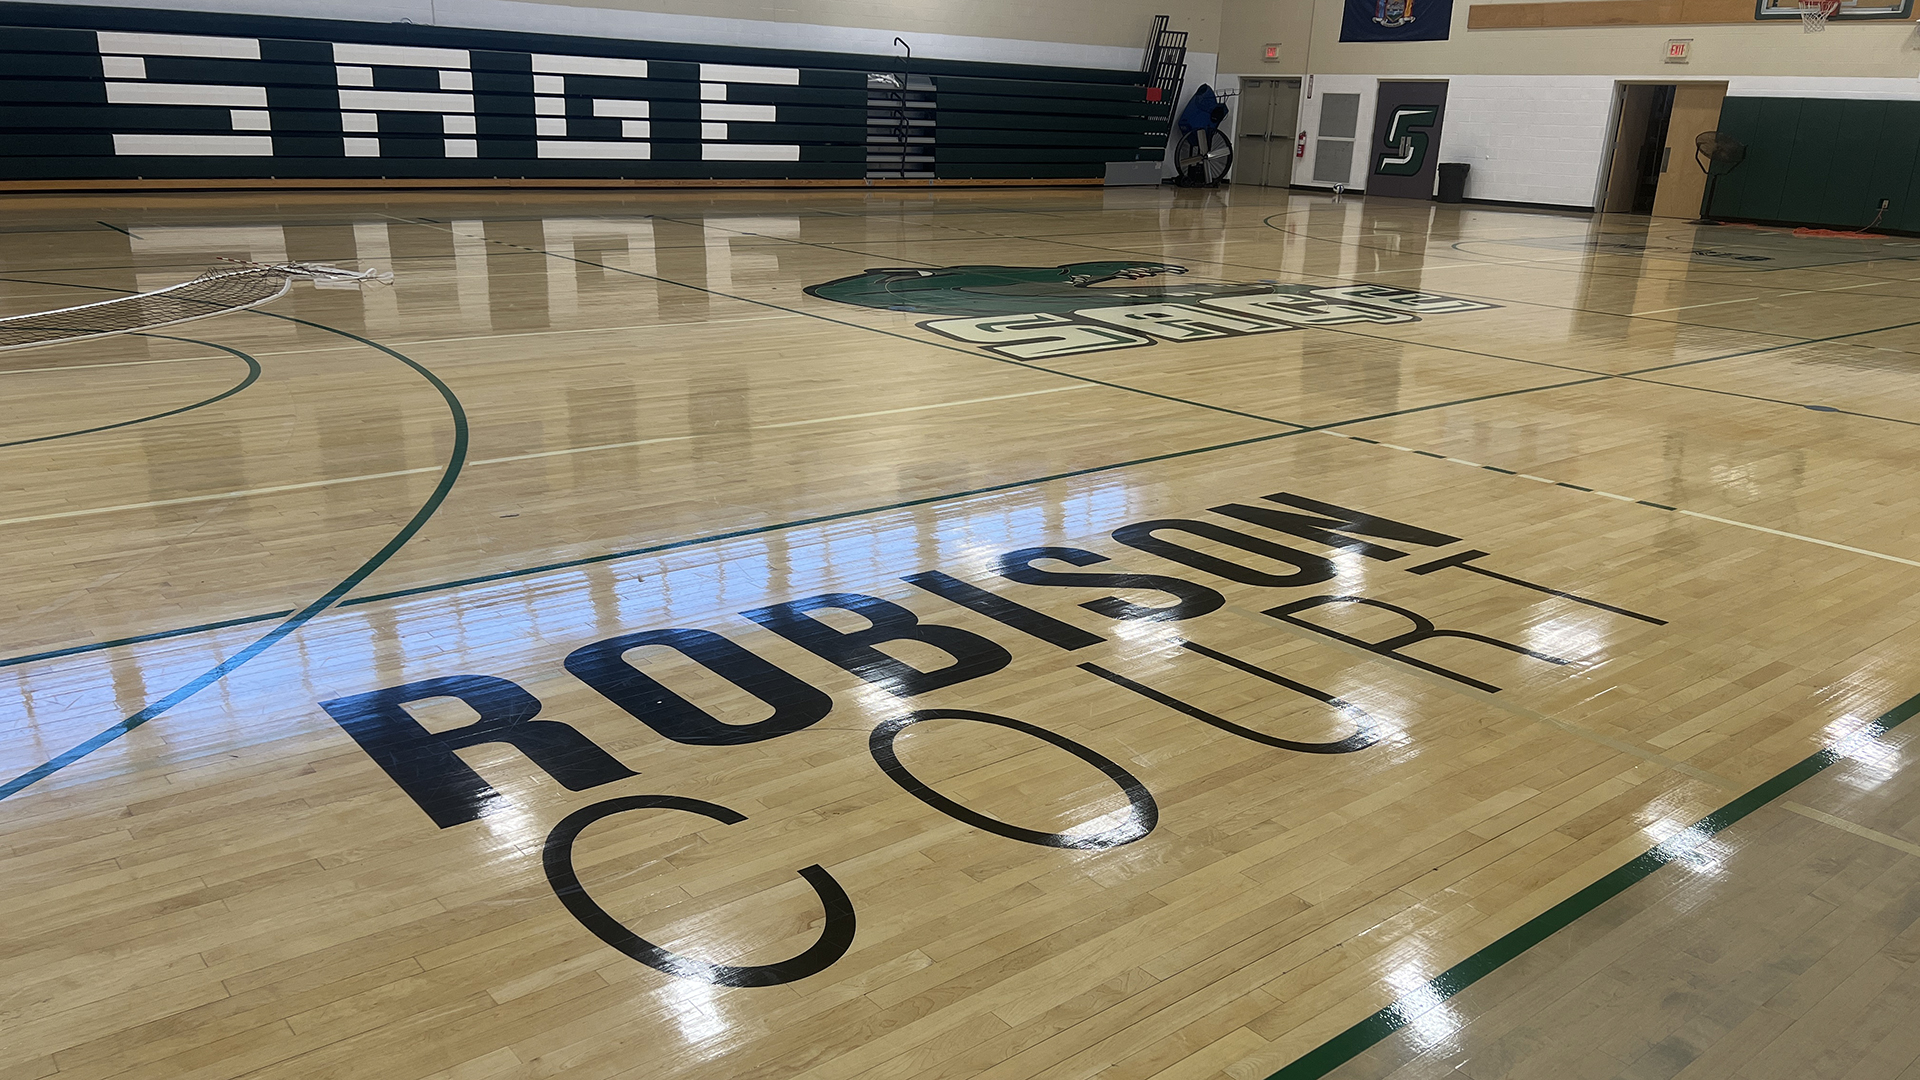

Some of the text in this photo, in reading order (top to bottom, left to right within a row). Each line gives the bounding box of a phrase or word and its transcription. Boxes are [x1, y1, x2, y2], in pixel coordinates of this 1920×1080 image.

[96, 30, 800, 160] SAGE
[1670, 44, 1685, 56] EXIT
[915, 284, 1506, 361] SAGE
[320, 491, 1462, 830] ROBISON
[542, 549, 1668, 988] COURT
